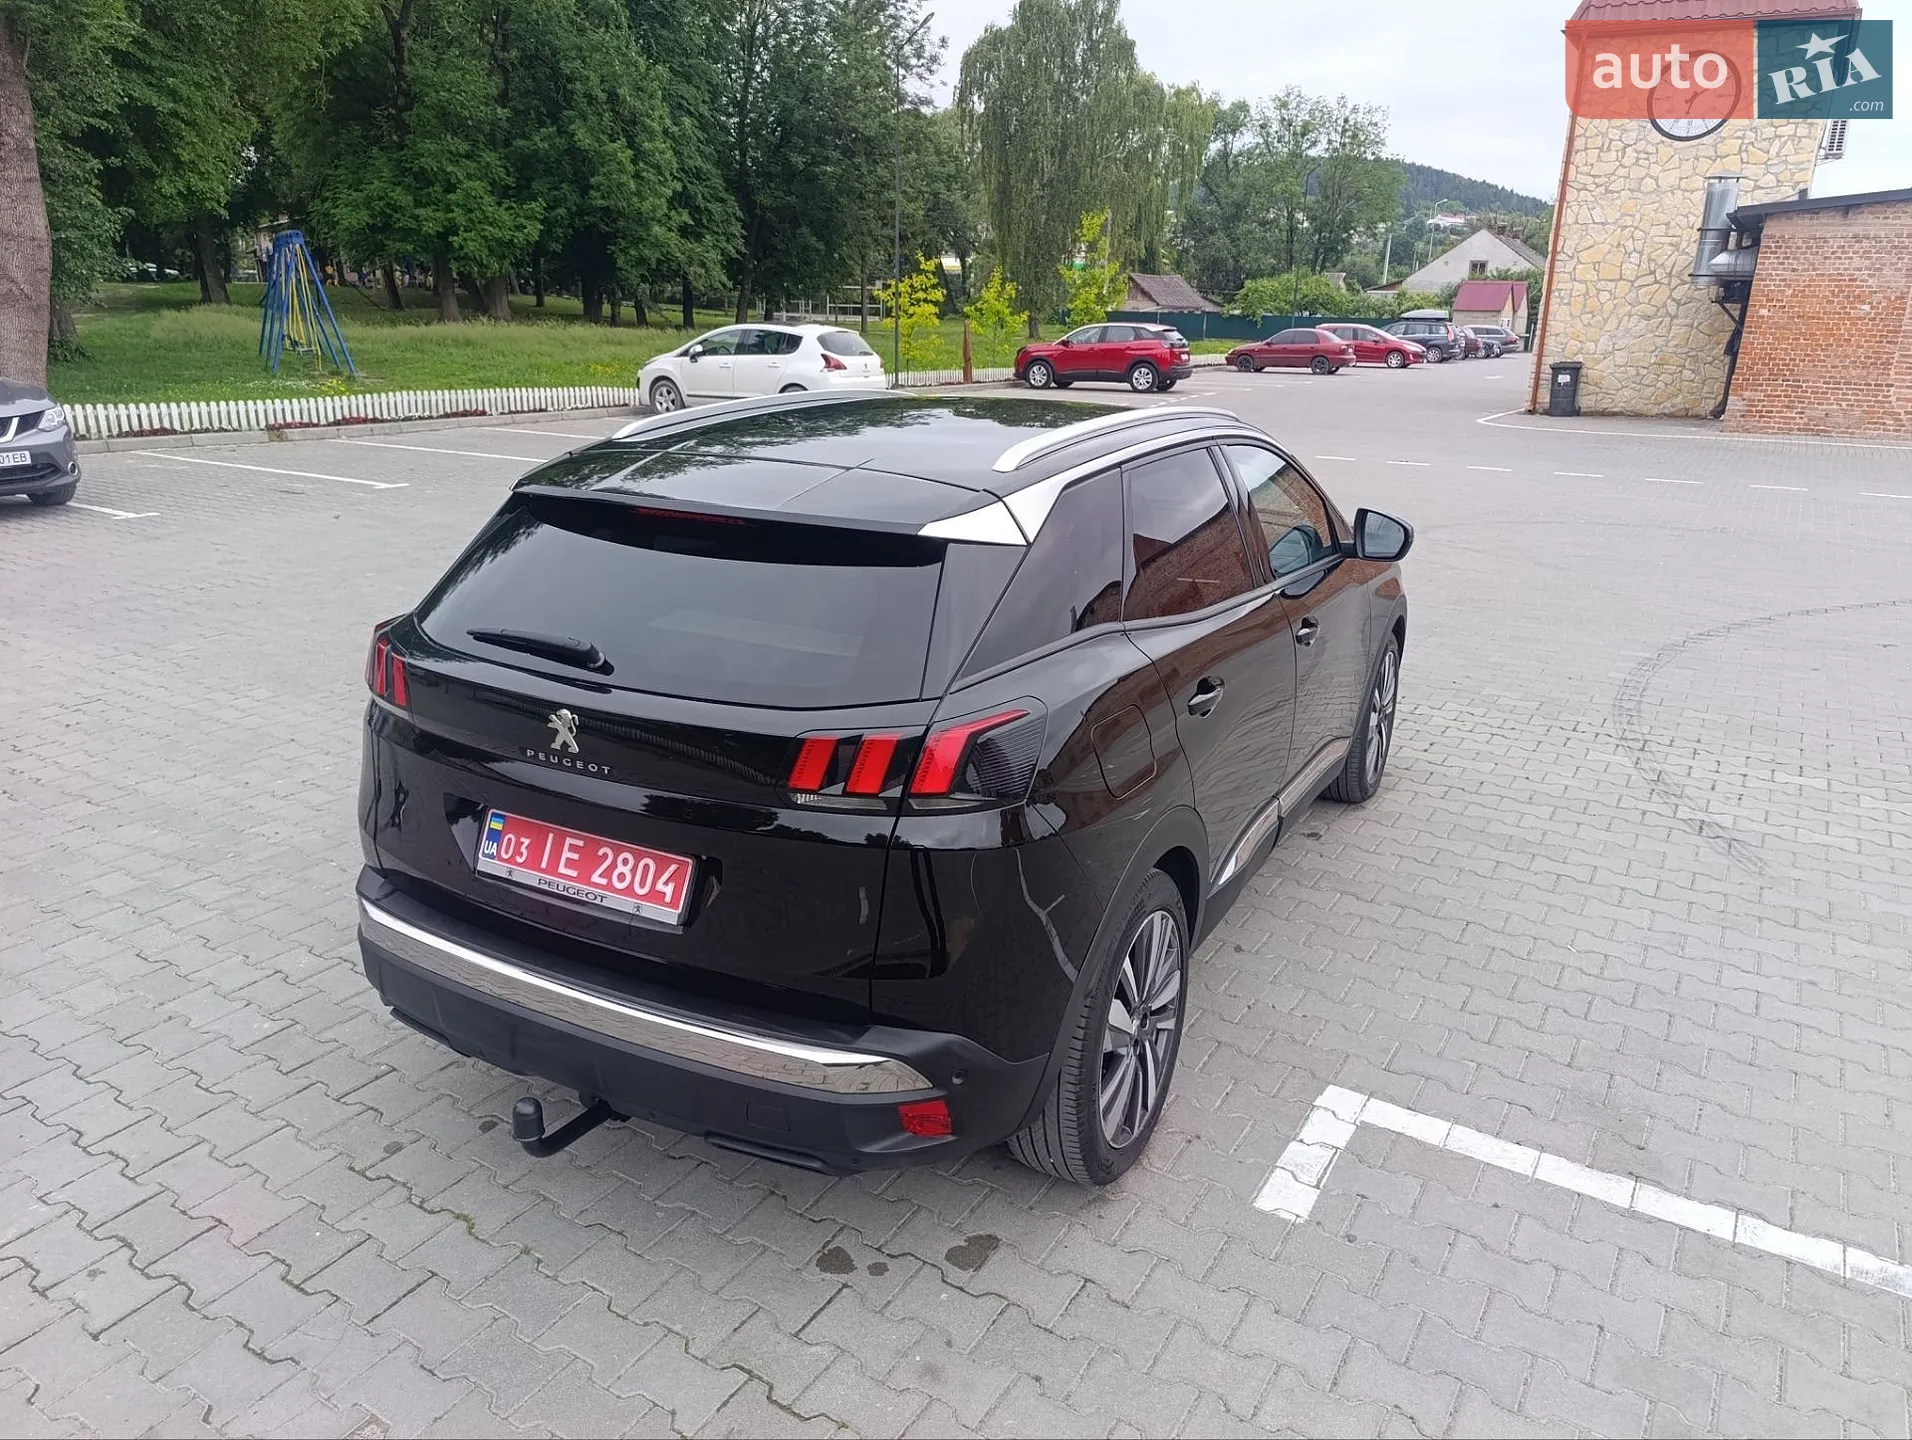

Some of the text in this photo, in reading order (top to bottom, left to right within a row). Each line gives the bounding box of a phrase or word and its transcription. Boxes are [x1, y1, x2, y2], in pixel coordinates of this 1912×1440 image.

[526, 749, 611, 775] PEUGEOT
[484, 840, 498, 855] UA
[500, 833, 680, 904] 03 IE 2804
[537, 878, 608, 904] PEUGEOT
